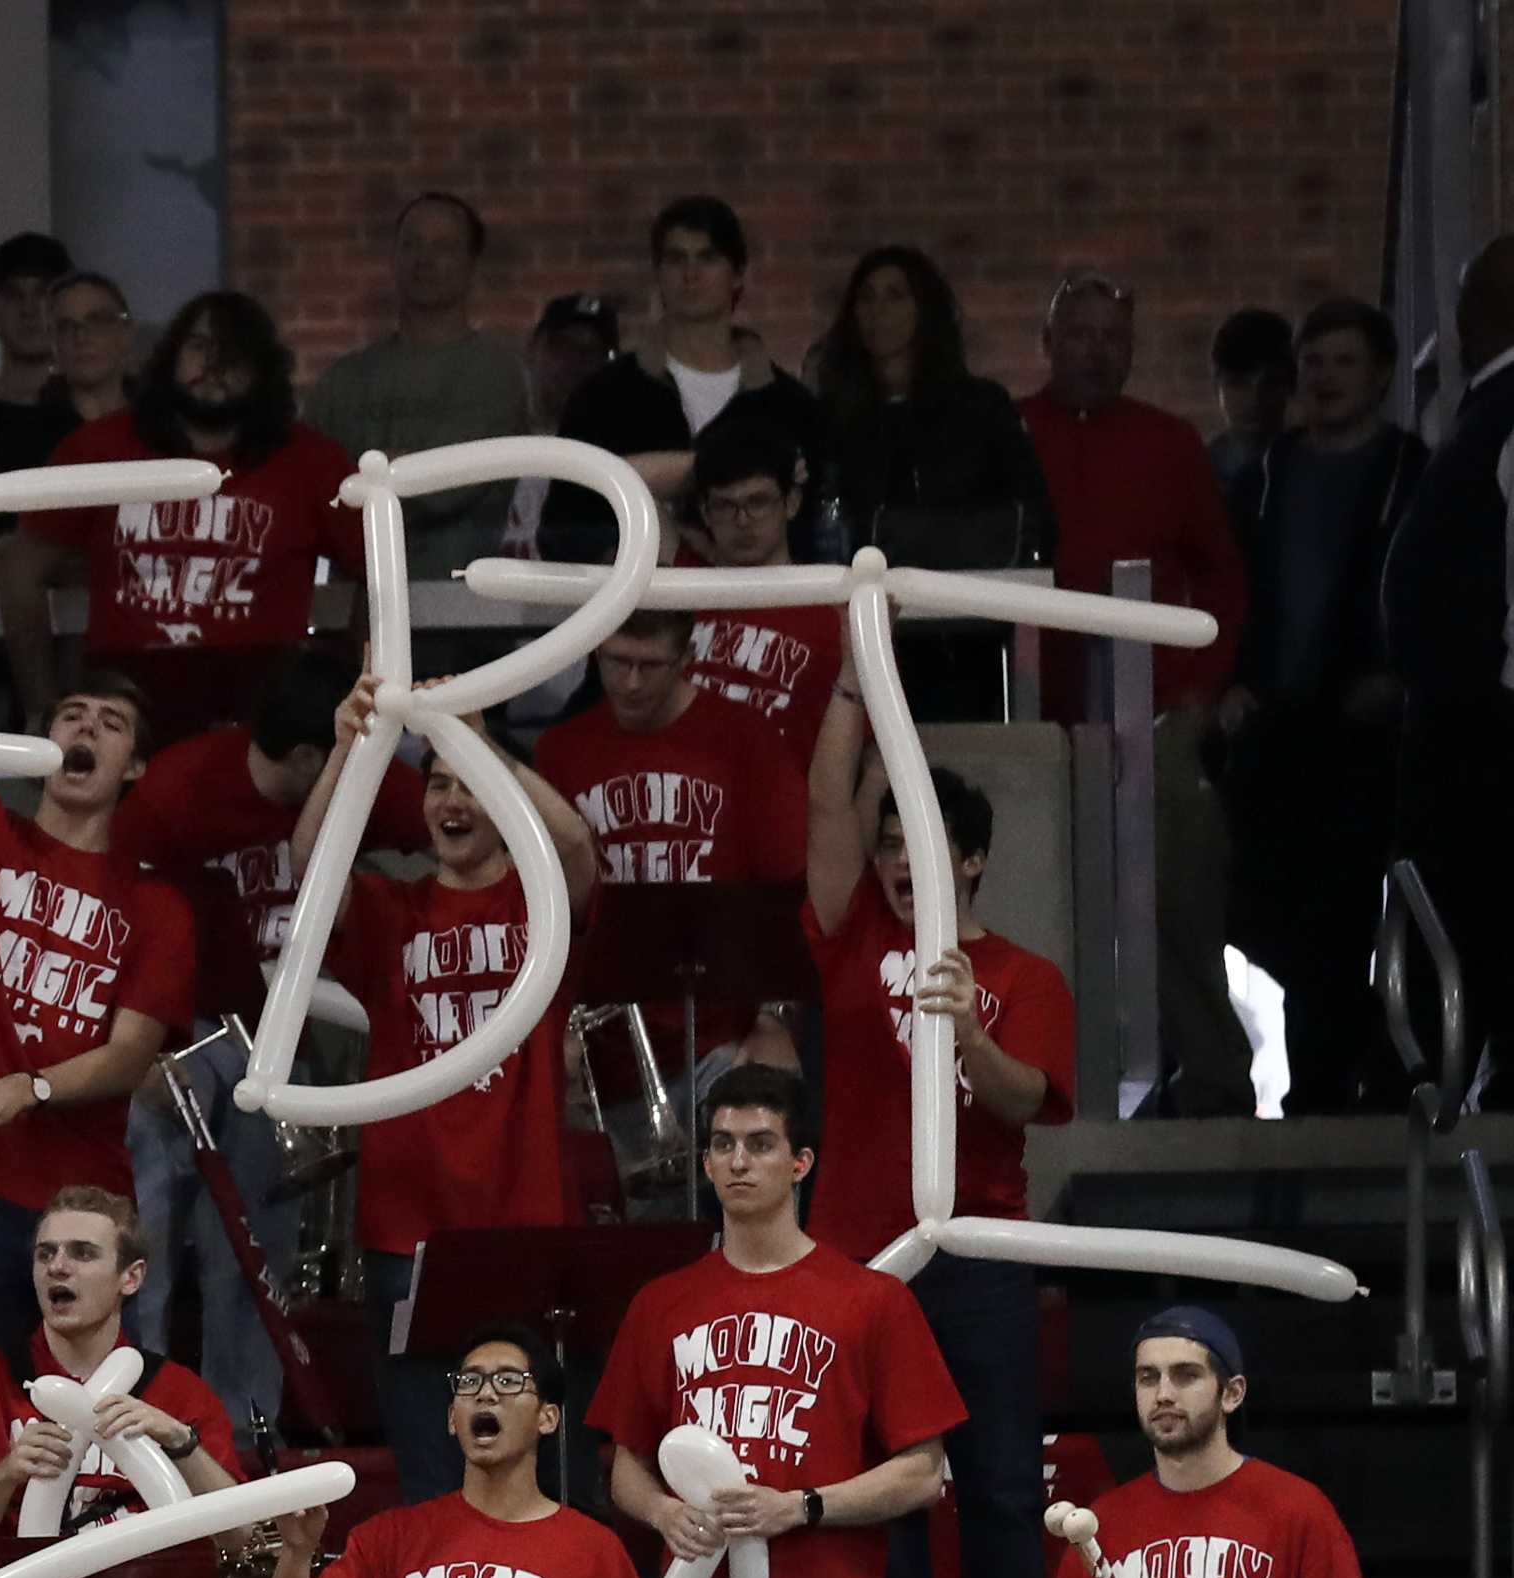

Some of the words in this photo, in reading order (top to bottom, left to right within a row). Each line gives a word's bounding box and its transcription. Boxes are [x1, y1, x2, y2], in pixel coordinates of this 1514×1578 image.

[575, 772, 722, 836] MOODY
[47, 1016, 101, 1038] OUT
[673, 1312, 836, 1391] MOODY
[679, 1383, 818, 1448] MAGIC
[769, 1447, 804, 1467] OUT
